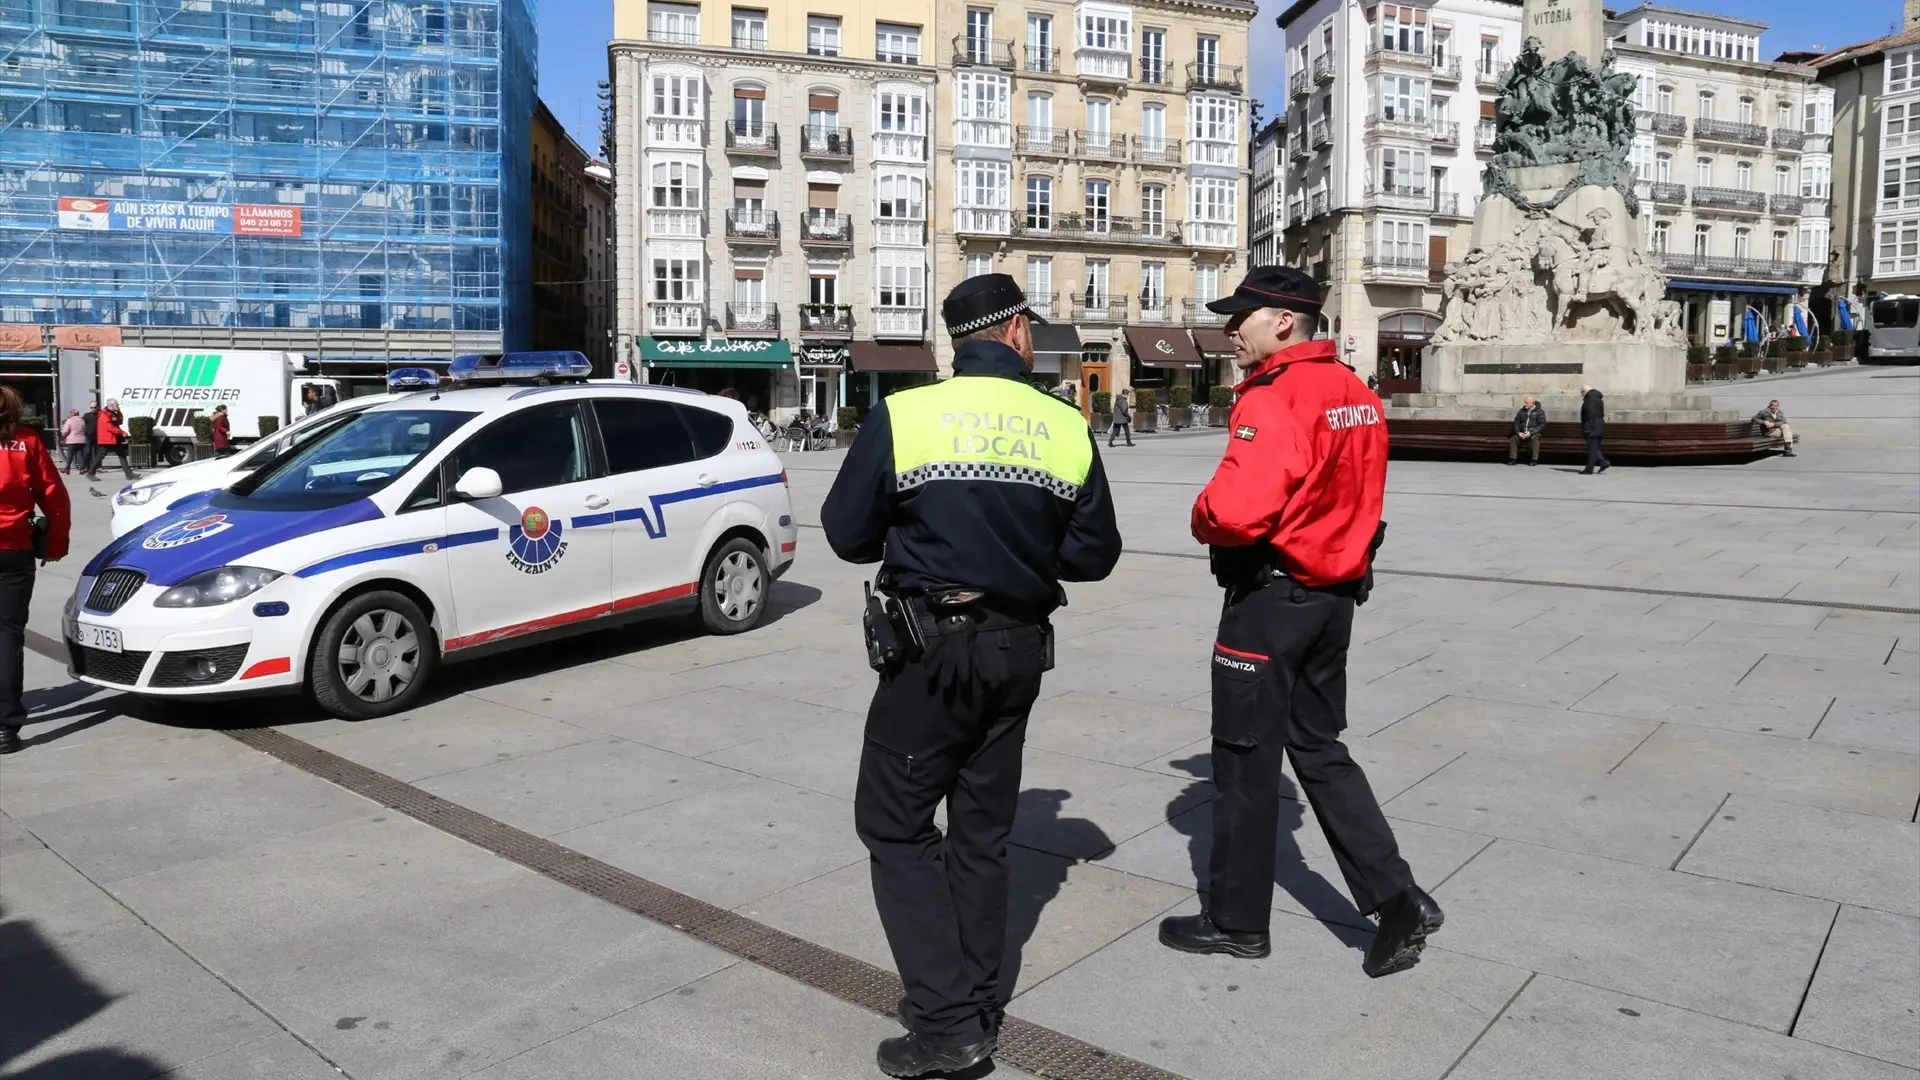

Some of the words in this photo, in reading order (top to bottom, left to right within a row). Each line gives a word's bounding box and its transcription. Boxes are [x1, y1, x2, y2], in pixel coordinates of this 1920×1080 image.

[1533, 8, 1572, 26] VITORIA
[114, 201, 138, 215] AÚN
[141, 202, 175, 216] ESTÁS
[188, 205, 229, 218] TIEMPO
[240, 207, 293, 218] LLÁMANOS
[127, 216, 142, 228] DE
[145, 217, 177, 230] VIVIR
[240, 218, 256, 226] 945
[258, 219, 269, 227] 23
[656, 340, 696, 356] Café
[121, 387, 163, 400] PETIT
[164, 388, 241, 401] FORESTIER
[941, 412, 1051, 441] POLICIA
[1325, 404, 1381, 432] ERTZINTZA
[742, 441, 756, 450] 112
[953, 434, 1042, 461] LOCAL
[505, 541, 568, 574] ERTZAINTZA
[94, 628, 118, 649] 2153
[1215, 655, 1256, 672] ERTZAINTZA
